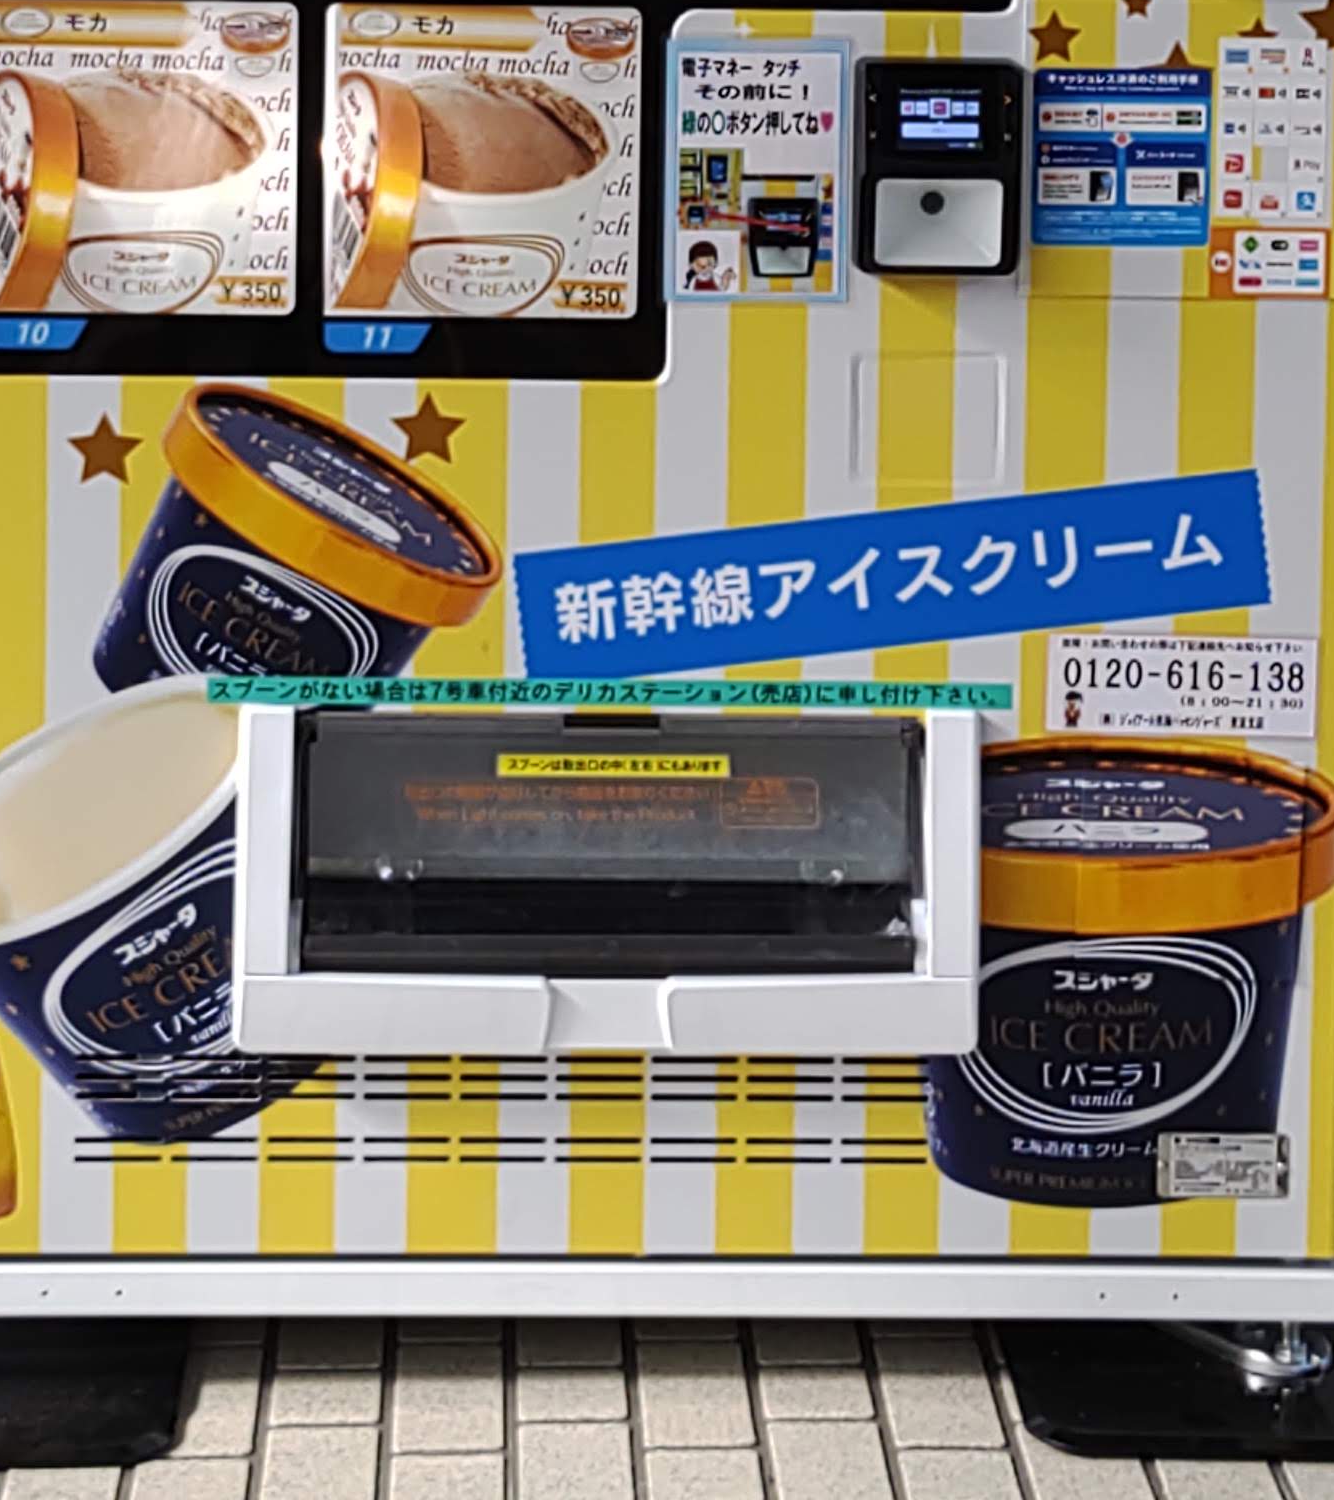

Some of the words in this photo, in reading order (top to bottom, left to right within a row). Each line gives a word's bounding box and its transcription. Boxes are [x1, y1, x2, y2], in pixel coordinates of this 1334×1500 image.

[65, 14, 107, 33] モカ
[412, 15, 455, 34] モカ
[151, 51, 225, 73] mocha
[498, 53, 570, 77] mocha
[682, 58, 752, 77] 電子マネー
[763, 58, 801, 77] タッチ
[17, 322, 50, 344] 10
[364, 327, 391, 350] 11
[555, 514, 1223, 644] 新幹線アイスクリーム
[1063, 657, 1304, 692] 0120-616-138
[114, 903, 197, 965] スジャータ
[1053, 970, 1154, 991] スジャータ
[87, 993, 149, 1033] ICE
[991, 1018, 1046, 1052] ICE
[1065, 1017, 1212, 1056] CREAM
[1070, 1089, 1135, 1108] vanilla
